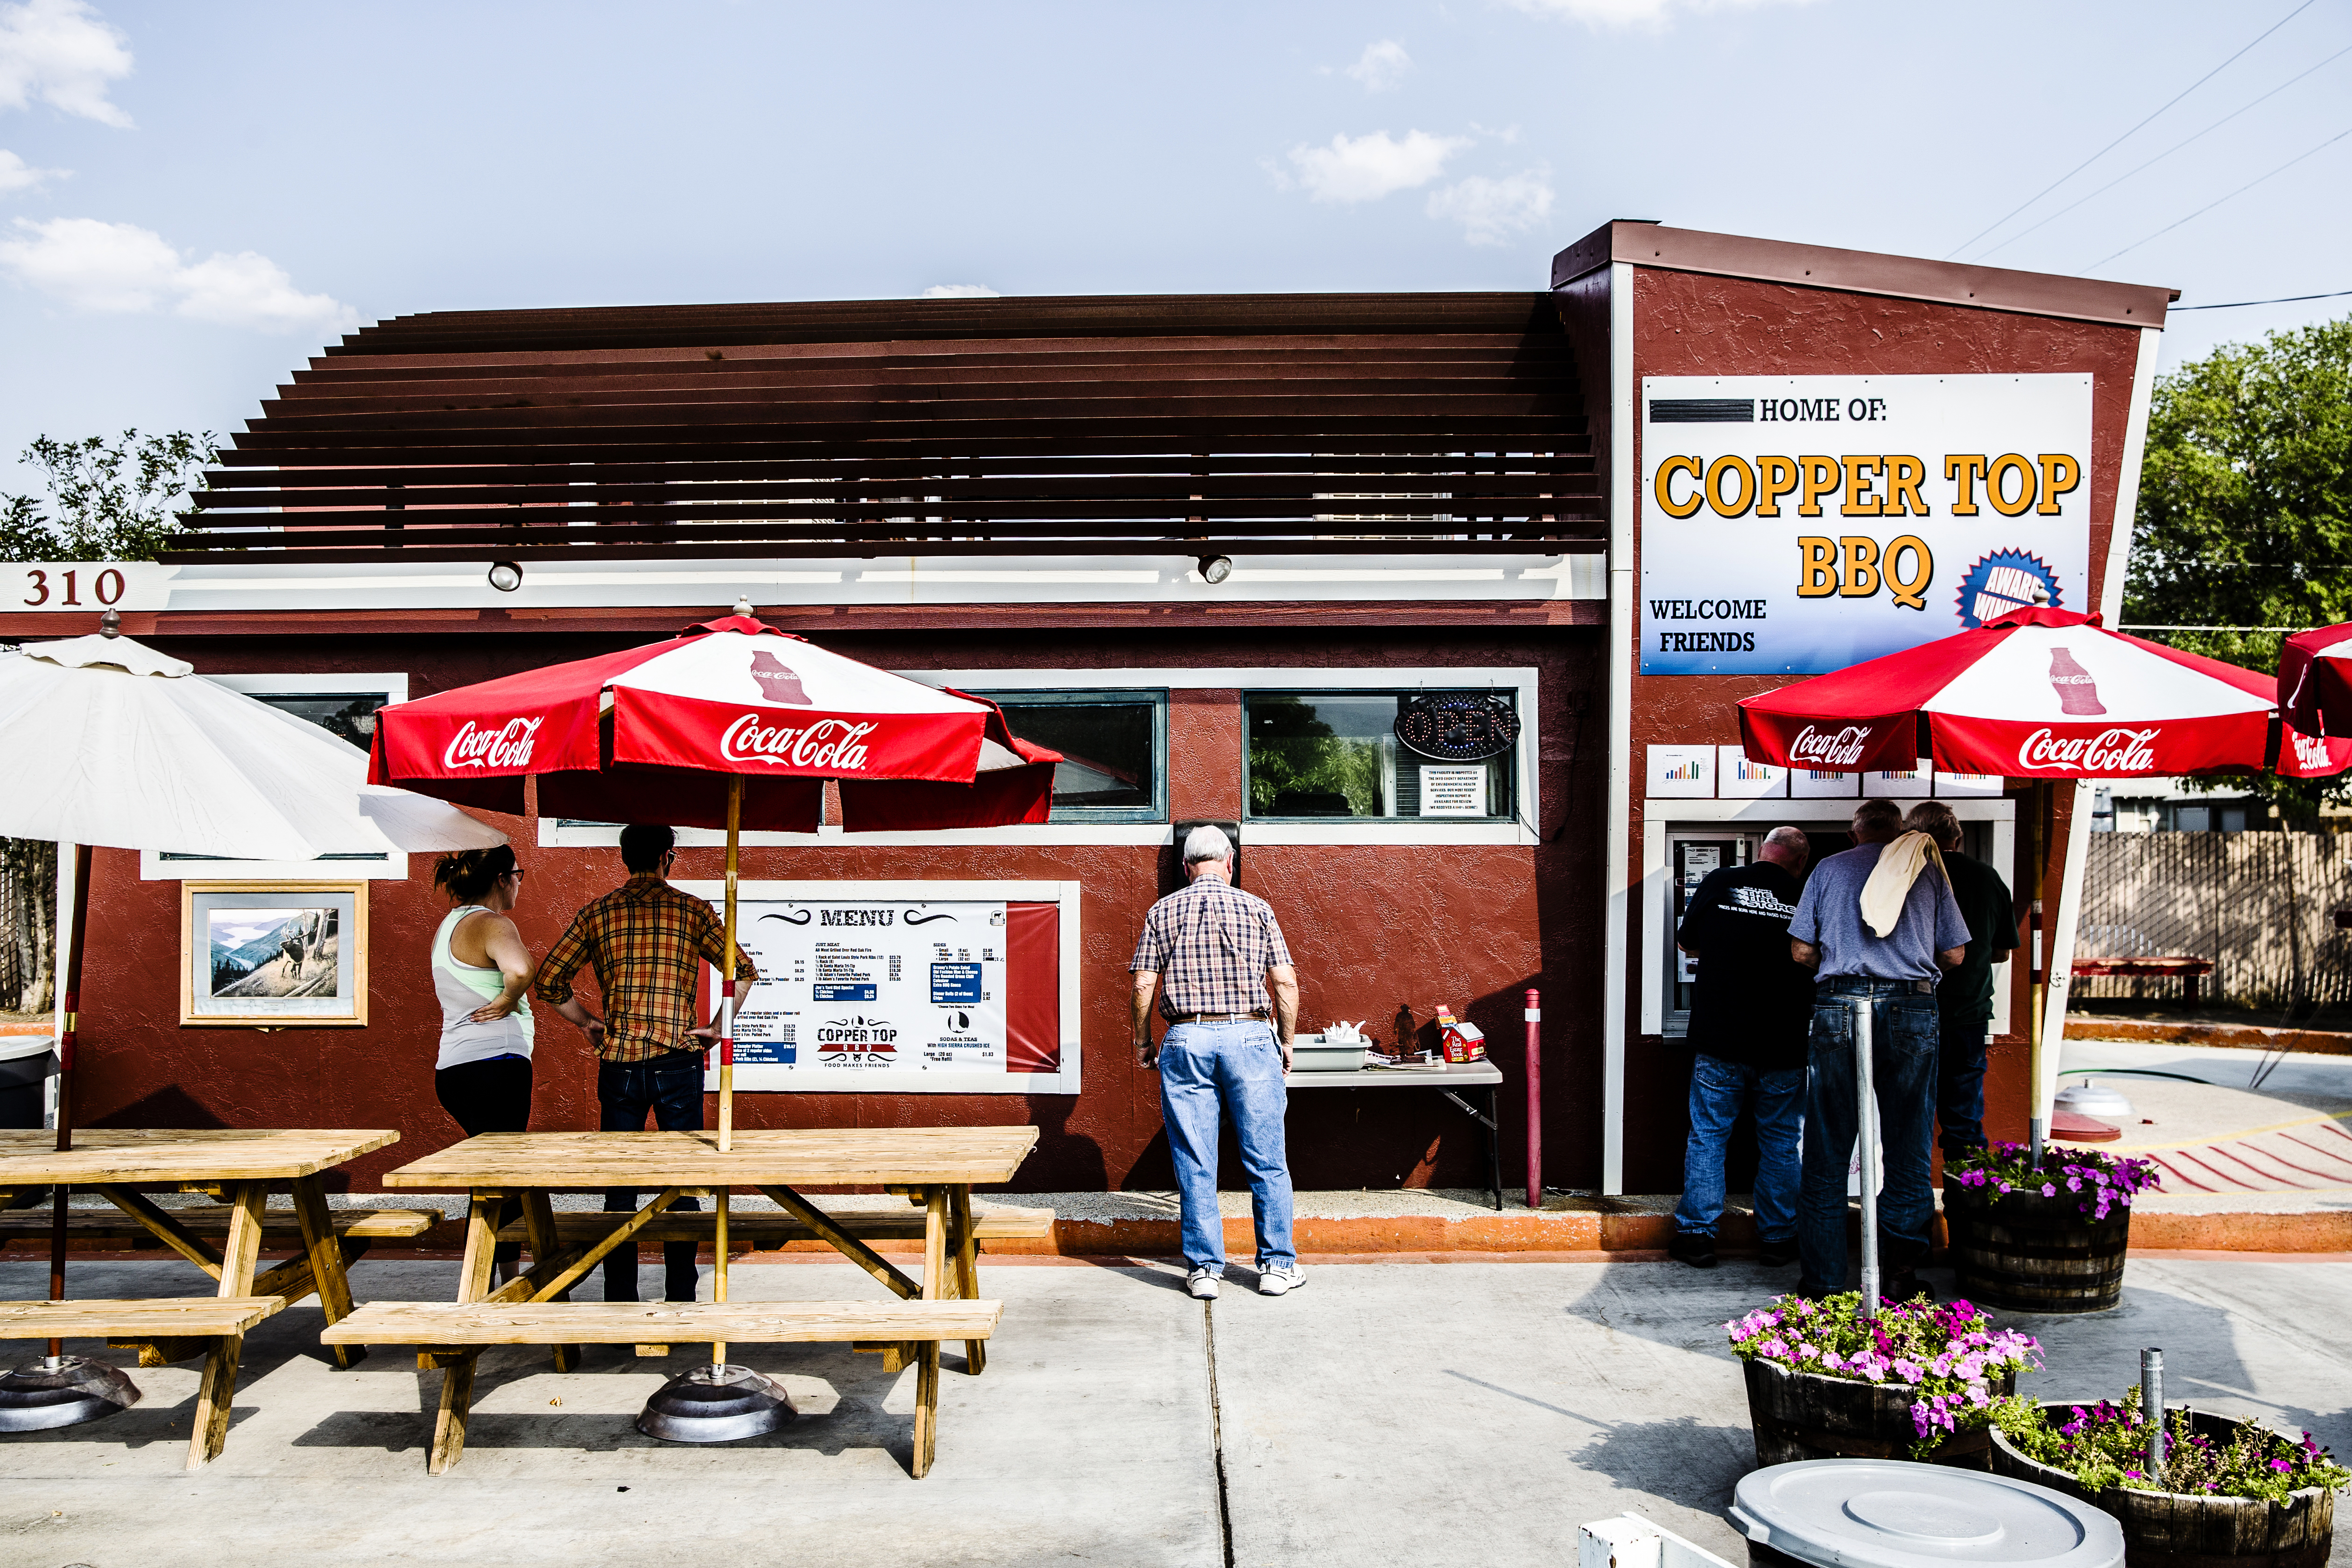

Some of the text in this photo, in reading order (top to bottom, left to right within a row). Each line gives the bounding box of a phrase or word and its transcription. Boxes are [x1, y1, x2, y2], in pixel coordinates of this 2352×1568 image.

[1760, 398, 1887, 422] HOME OF:
[1654, 453, 2081, 520] COPPER TOP
[1797, 534, 1933, 611] BBQ
[24, 569, 125, 605] 310
[1984, 566, 2042, 604] AWARD
[1649, 599, 1767, 620] WELCOME
[1660, 631, 1755, 653] FRIENDS
[751, 669, 801, 680] Coca-Cola
[2050, 674, 2094, 685] Coca-Cola
[1404, 710, 1512, 742] OPEN
[444, 716, 544, 769] Coca-Cola
[720, 713, 879, 770] Coca-Cola
[1789, 724, 1872, 765] Coca-Cola
[2018, 728, 2161, 771] Coca-Cola
[1745, 890, 1773, 899] THE
[1746, 895, 1778, 905] TIRE
[820, 909, 894, 927] MENU
[1746, 900, 1796, 914] STORE
[817, 1028, 897, 1042] COPPER TOP
